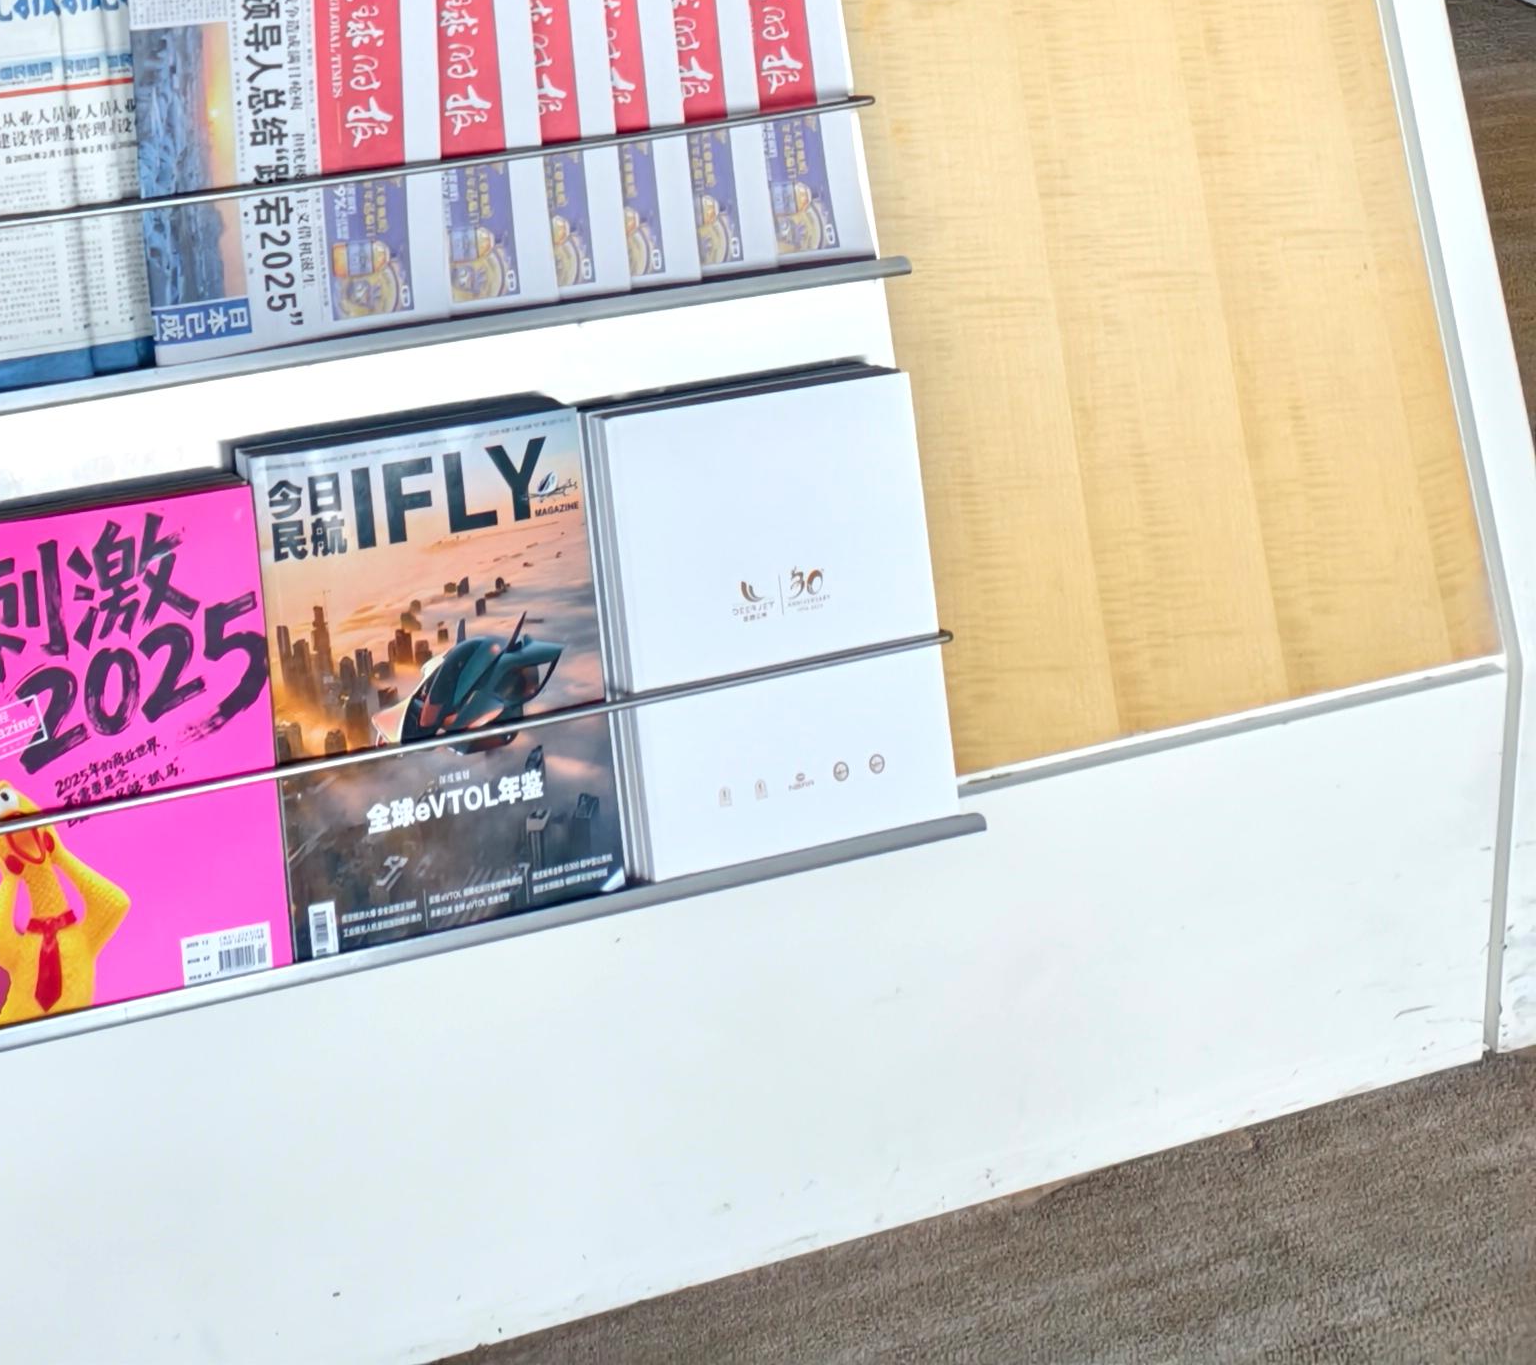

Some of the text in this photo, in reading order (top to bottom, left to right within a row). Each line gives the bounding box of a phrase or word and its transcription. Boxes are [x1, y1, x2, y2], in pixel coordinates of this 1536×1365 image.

[331, 53, 345, 99] TIMES
[291, 132, 315, 289] 担忧极主义借机滋生
[154, 306, 249, 342] 日本已成
[267, 472, 342, 521] 今日
[350, 435, 547, 550] IFLY
[534, 500, 580, 518] MAGAZINE
[271, 514, 349, 562] 民航
[9, 591, 270, 775] 2025
[366, 769, 545, 835] 全球eVTOL年鉴
